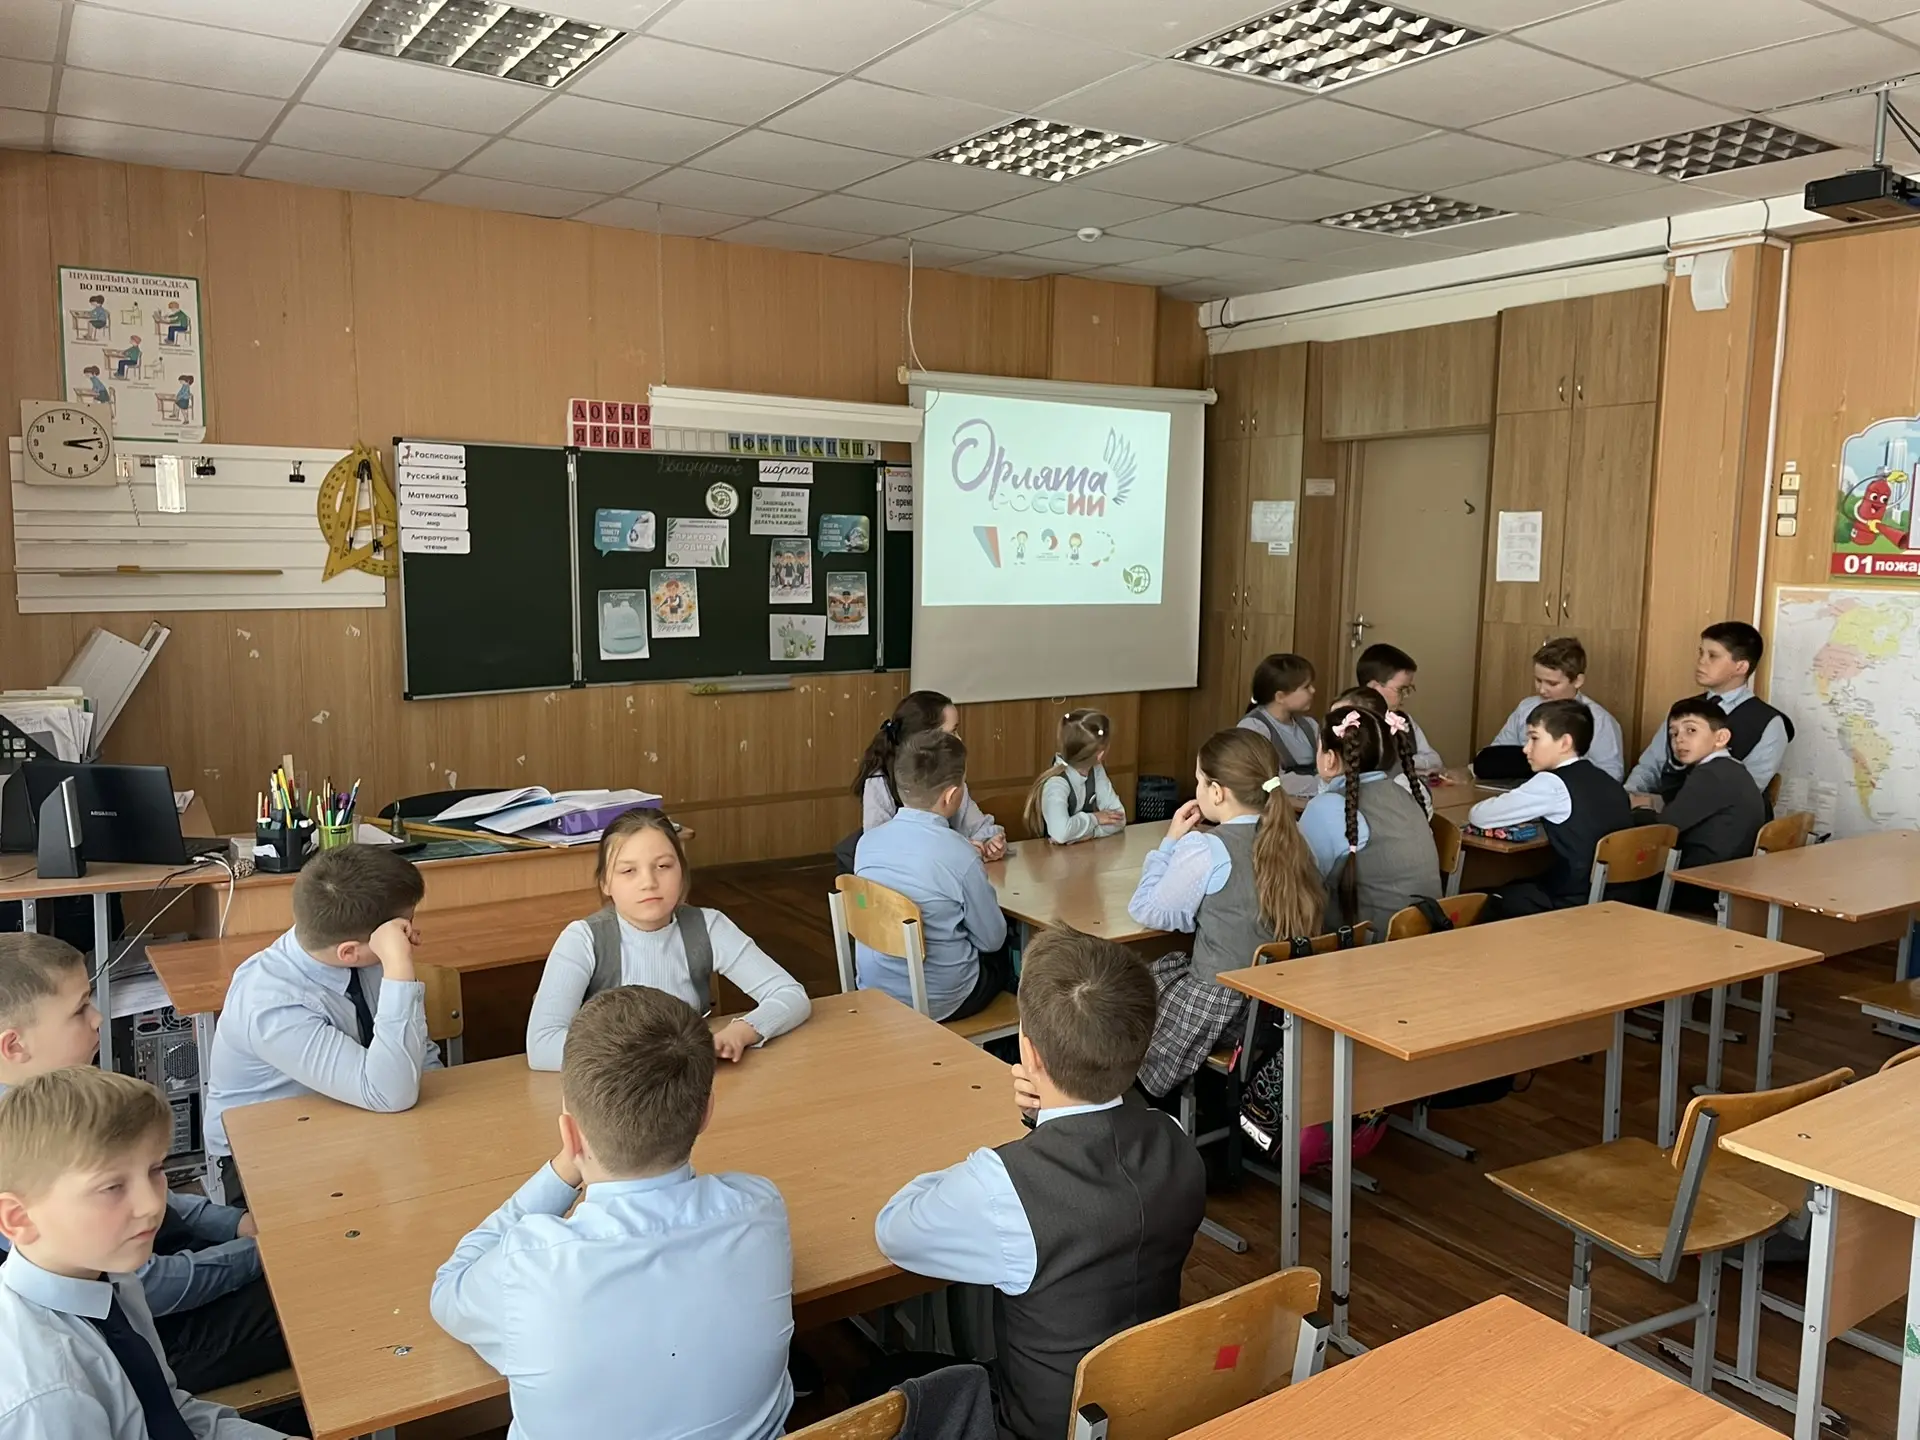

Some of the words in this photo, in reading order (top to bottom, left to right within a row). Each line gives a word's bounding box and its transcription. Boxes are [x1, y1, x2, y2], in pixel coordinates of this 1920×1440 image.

[68, 271, 139, 285] ПРАВИЛЬНАЯ
[141, 278, 189, 289] ПОСАДКА
[80, 283, 93, 291] ВО
[95, 285, 130, 294] ВРЕМЯ
[131, 287, 180, 298] ЗАНЯТИЙ
[62, 412, 71, 421] 12
[574, 403, 586, 419] А
[590, 404, 601, 419] О
[606, 406, 618, 420] У
[621, 406, 635, 421] Ы
[80, 417, 84, 425] 1
[36, 425, 45, 433] 10
[92, 427, 98, 435] 2
[575, 428, 585, 443] Я
[592, 426, 601, 443] Ё
[606, 429, 619, 444] Ю
[624, 430, 634, 445] И
[641, 432, 650, 446] Е
[34, 439, 39, 447] 9
[98, 441, 103, 449] 3
[38, 452, 44, 460] 8
[93, 454, 99, 462] 4
[414, 451, 463, 460] Расписание
[952, 418, 1108, 501] Орлята
[52, 463, 57, 471] 7
[68, 467, 73, 475] 6
[83, 463, 89, 472] 5
[406, 472, 440, 481] Русский
[407, 491, 459, 500] Математика
[410, 509, 457, 518] Окружающий
[411, 534, 460, 542] Литературное
[673, 532, 718, 542] ПРИРОДА
[677, 542, 716, 552] РОДИНА
[1844, 554, 1873, 573] 01
